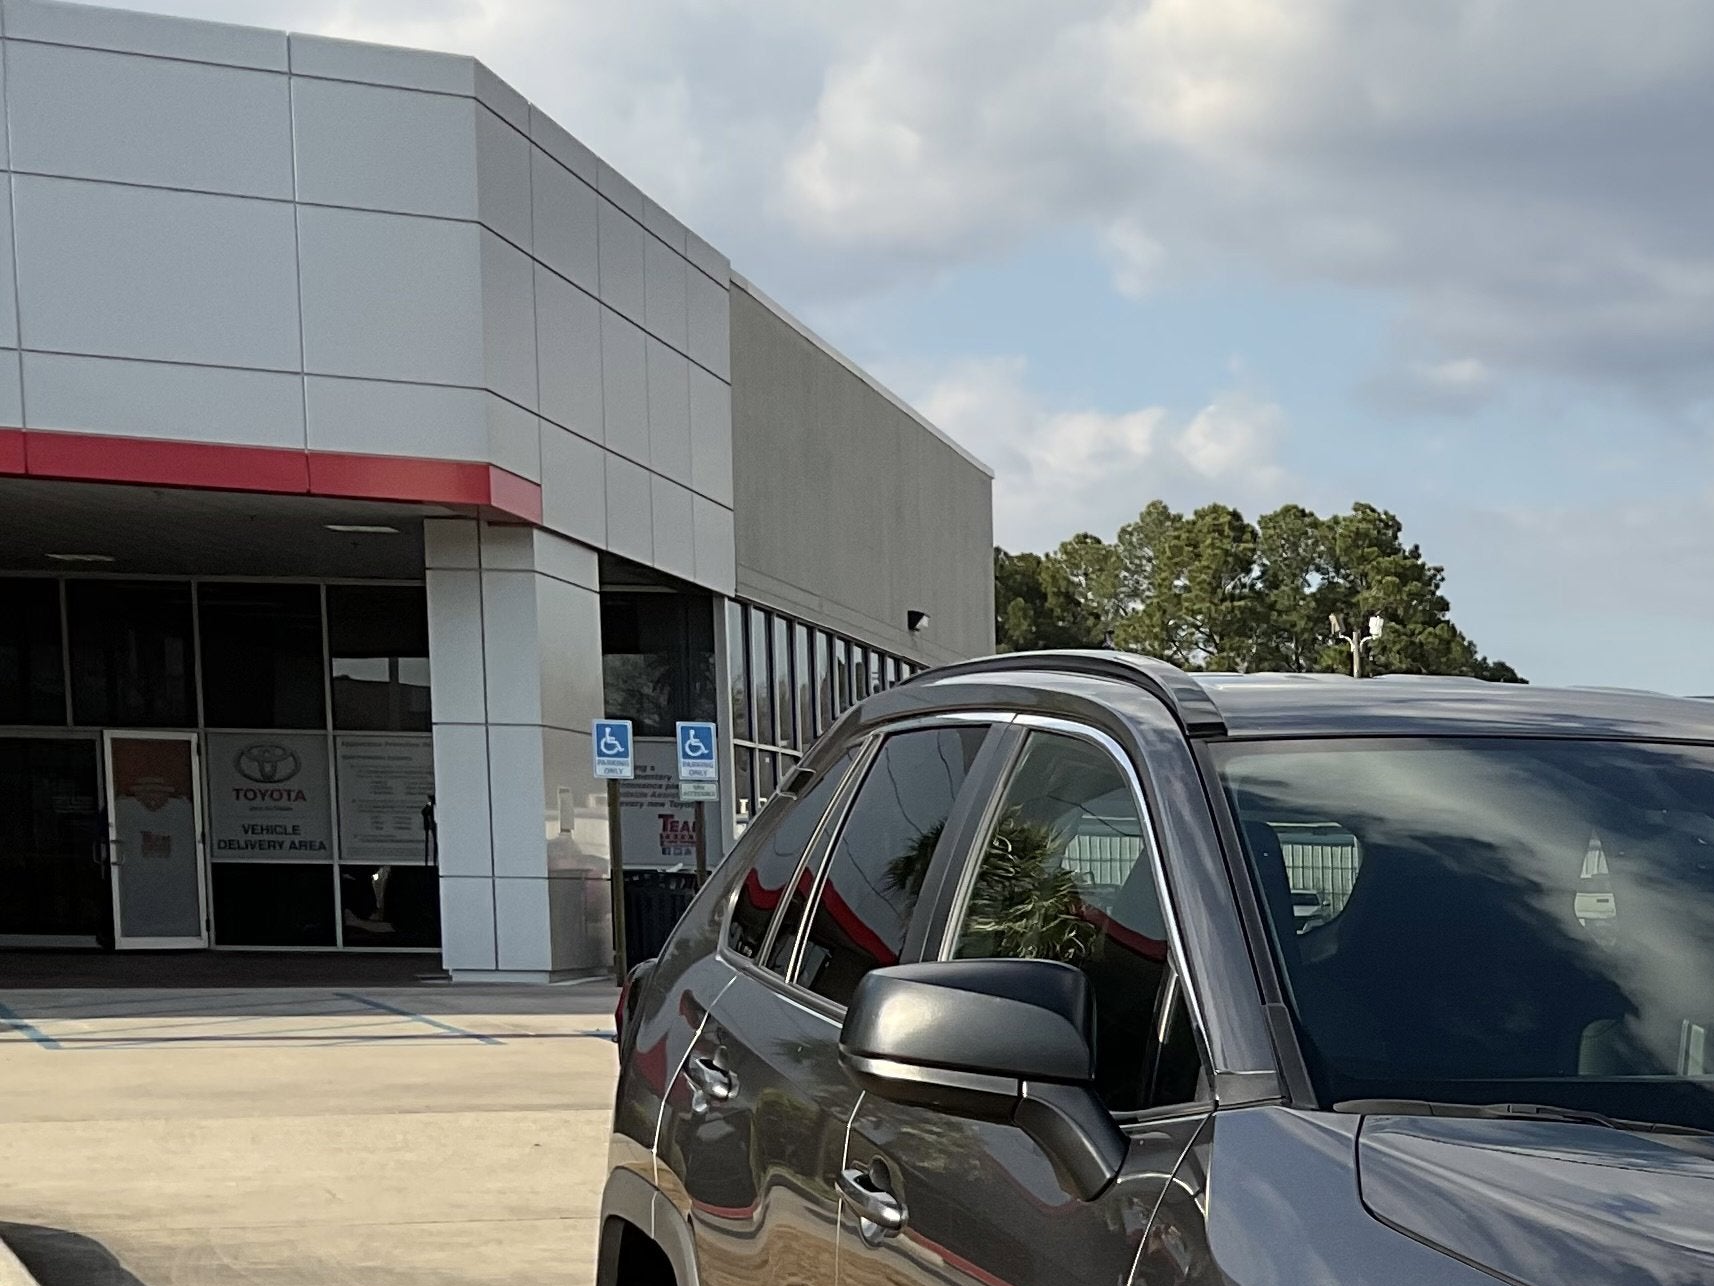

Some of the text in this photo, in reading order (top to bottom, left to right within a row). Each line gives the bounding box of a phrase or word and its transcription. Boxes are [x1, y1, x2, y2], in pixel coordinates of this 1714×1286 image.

[603, 767, 624, 775] ONLY
[688, 768, 708, 776] ONLY
[233, 788, 306, 802] TOYOTA
[658, 814, 697, 832] TEA
[242, 824, 300, 836] VEHICLE
[217, 839, 327, 851] DELIVERY AREA
